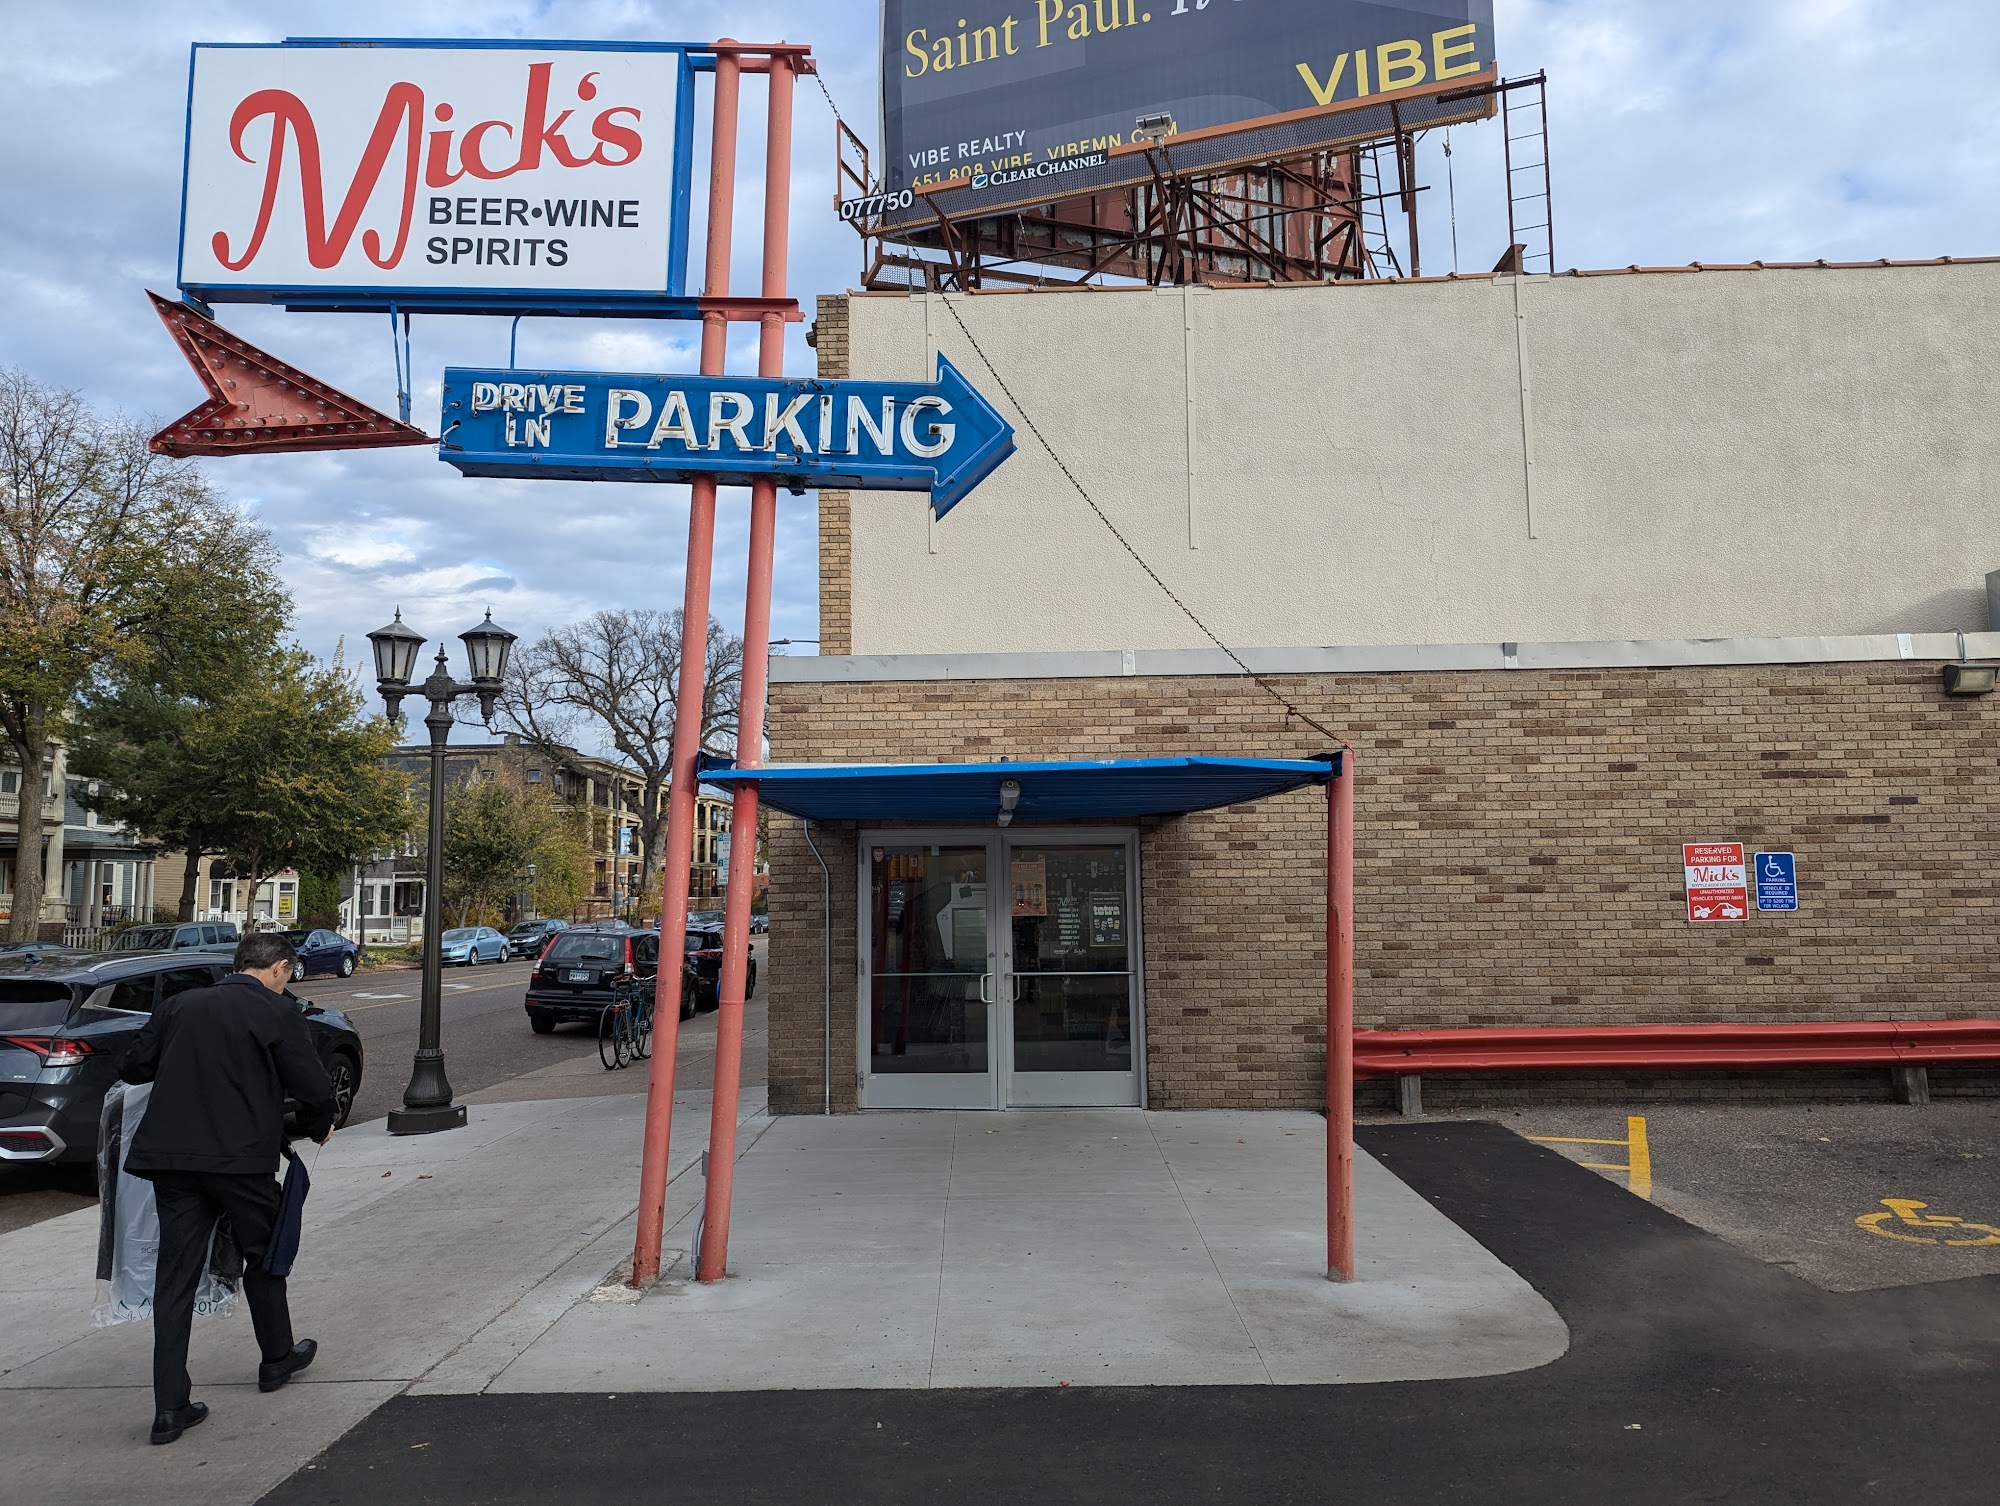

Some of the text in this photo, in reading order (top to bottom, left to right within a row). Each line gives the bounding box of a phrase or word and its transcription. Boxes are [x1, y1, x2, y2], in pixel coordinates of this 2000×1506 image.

[905, 0, 1151, 78] Saint Paul.
[1295, 23, 1481, 106] VIBE
[211, 61, 643, 272] Mick's
[908, 129, 1026, 169] VIBE REALTY
[840, 189, 913, 220] 077750
[425, 236, 569, 268] SPIRITS
[472, 381, 586, 414] DRIVE
[505, 411, 552, 448] IN
[604, 388, 956, 458] PARKING
[1694, 847, 1732, 855] RESERVED
[1722, 855, 1738, 863] FOR
[1693, 866, 1740, 883] Mick's
